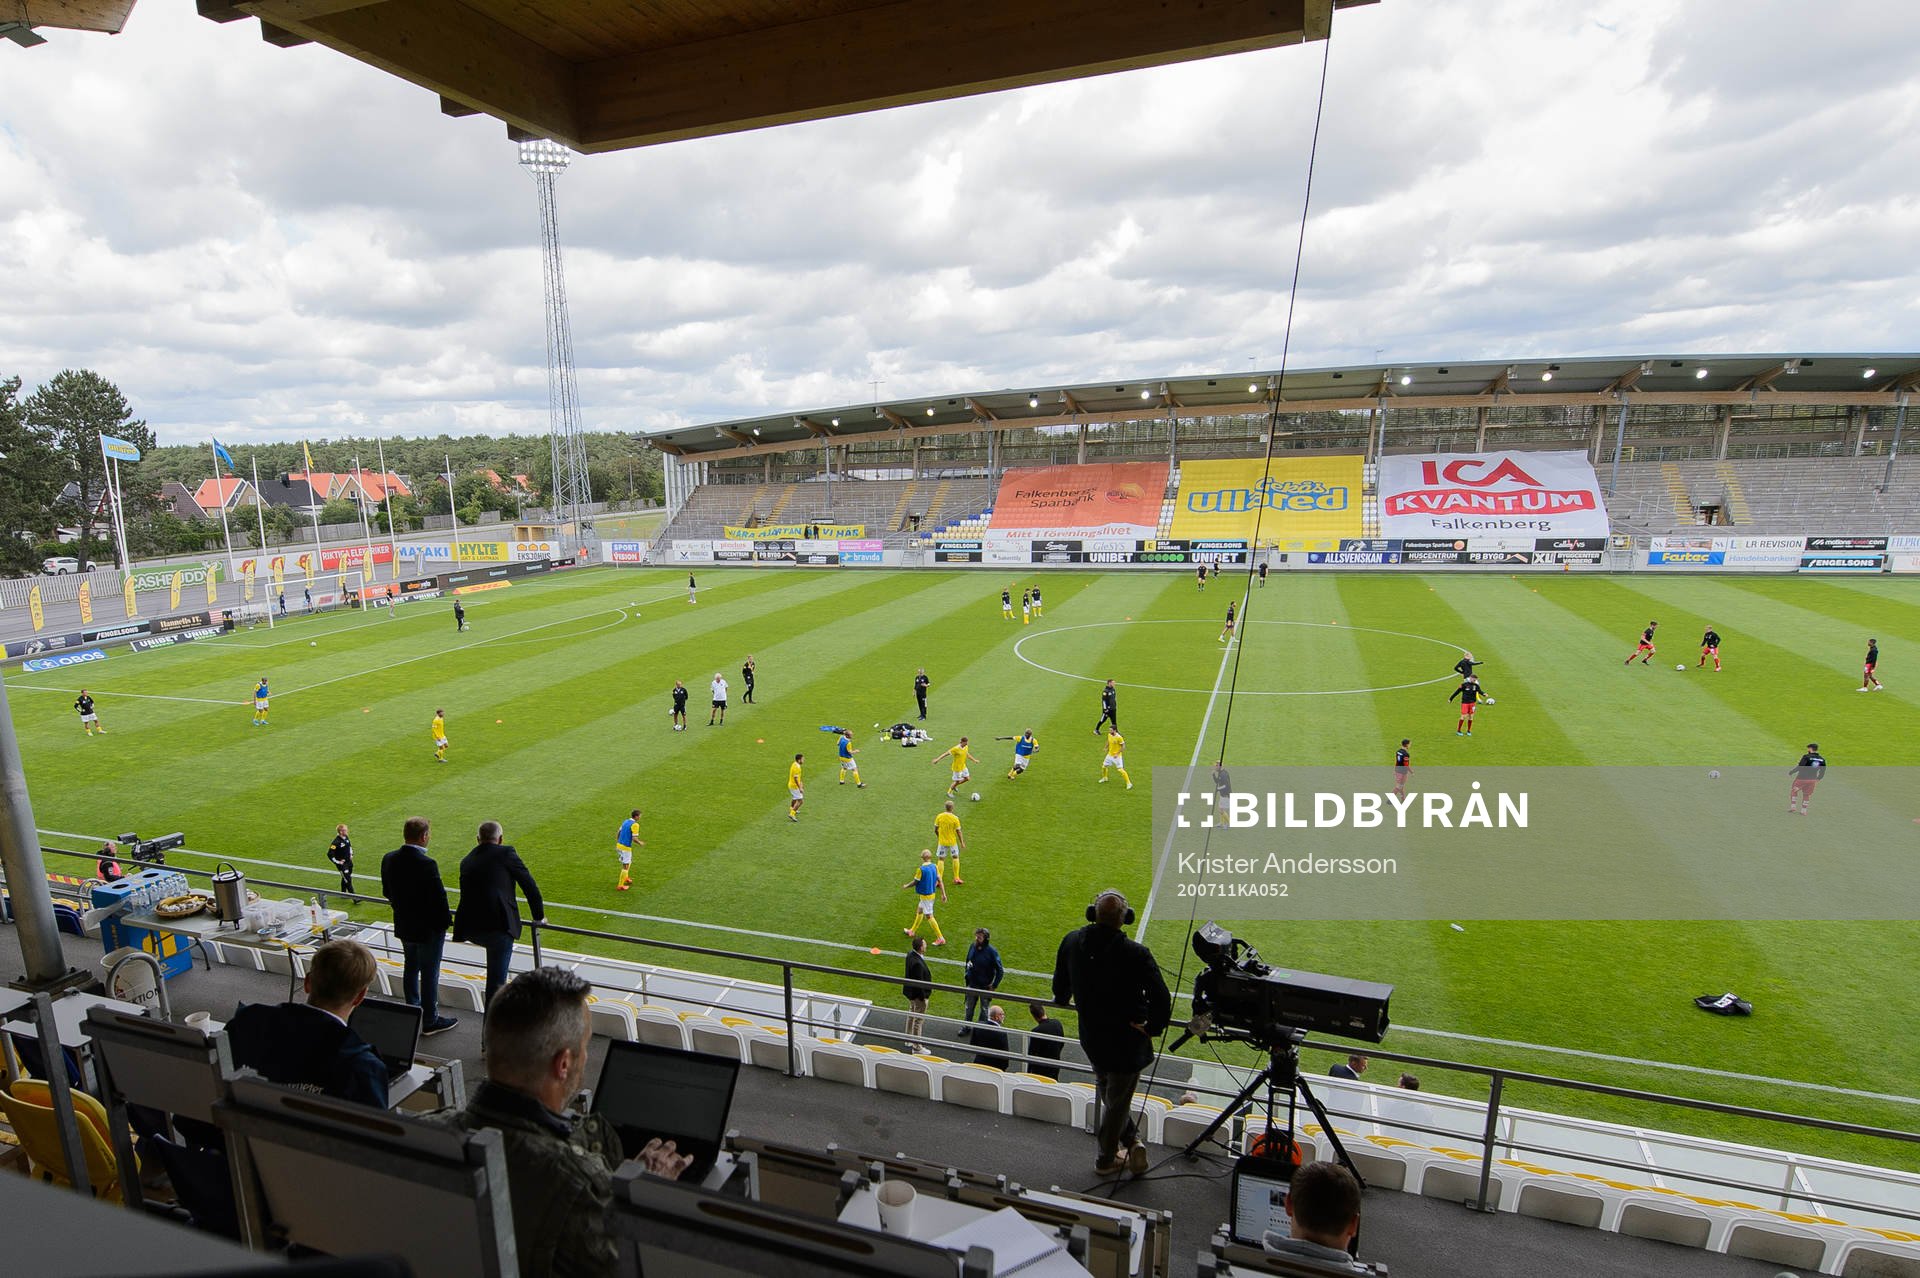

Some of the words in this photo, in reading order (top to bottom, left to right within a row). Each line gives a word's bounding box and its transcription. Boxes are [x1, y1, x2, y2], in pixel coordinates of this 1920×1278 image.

[1422, 457, 1545, 487] ICA
[1254, 477, 1328, 494] Gekås
[1187, 486, 1348, 512] ullared
[1395, 492, 1583, 511] KVANTUM
[1431, 518, 1551, 531] Falkenberg
[459, 543, 498, 555] HYLTE
[1745, 540, 1757, 548] LR
[1760, 540, 1803, 548] REVISION
[1089, 553, 1134, 562] UNIBET
[1191, 552, 1239, 563] UNIBET
[1324, 552, 1383, 564] ALLSVENSKAN
[1408, 552, 1458, 560] HUSCENTRUM
[1534, 552, 1553, 564] XL
[1661, 552, 1709, 562] Fastec
[1728, 554, 1797, 562] Handelsbanken
[1816, 559, 1874, 567] ENGELSONS
[140, 633, 179, 647] UNIBET
[184, 626, 221, 640] UNIBET
[59, 651, 105, 666] OBOS
